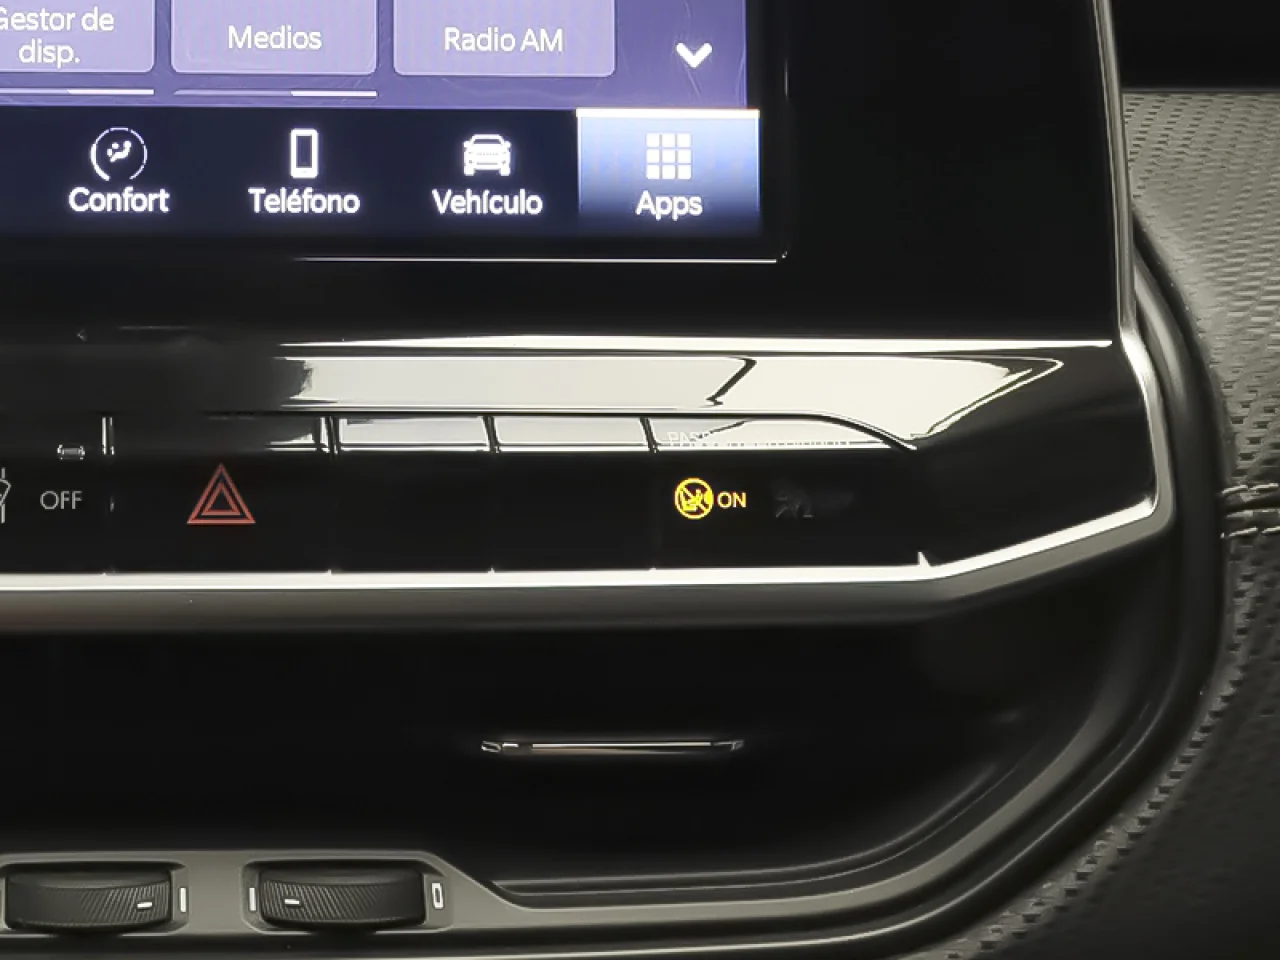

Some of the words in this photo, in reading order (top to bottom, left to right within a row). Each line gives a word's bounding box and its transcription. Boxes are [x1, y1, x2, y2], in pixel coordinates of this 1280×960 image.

[81, 5, 115, 32] de
[227, 24, 323, 51] Medios
[443, 26, 517, 53] Radio
[520, 28, 564, 53] AM
[18, 39, 80, 69] disp.
[67, 187, 171, 214] Confort
[247, 187, 361, 215] Teléfono
[431, 189, 544, 216] Vehículo
[635, 191, 703, 221] Apps
[39, 490, 83, 510] OFF
[717, 491, 747, 509] ON
